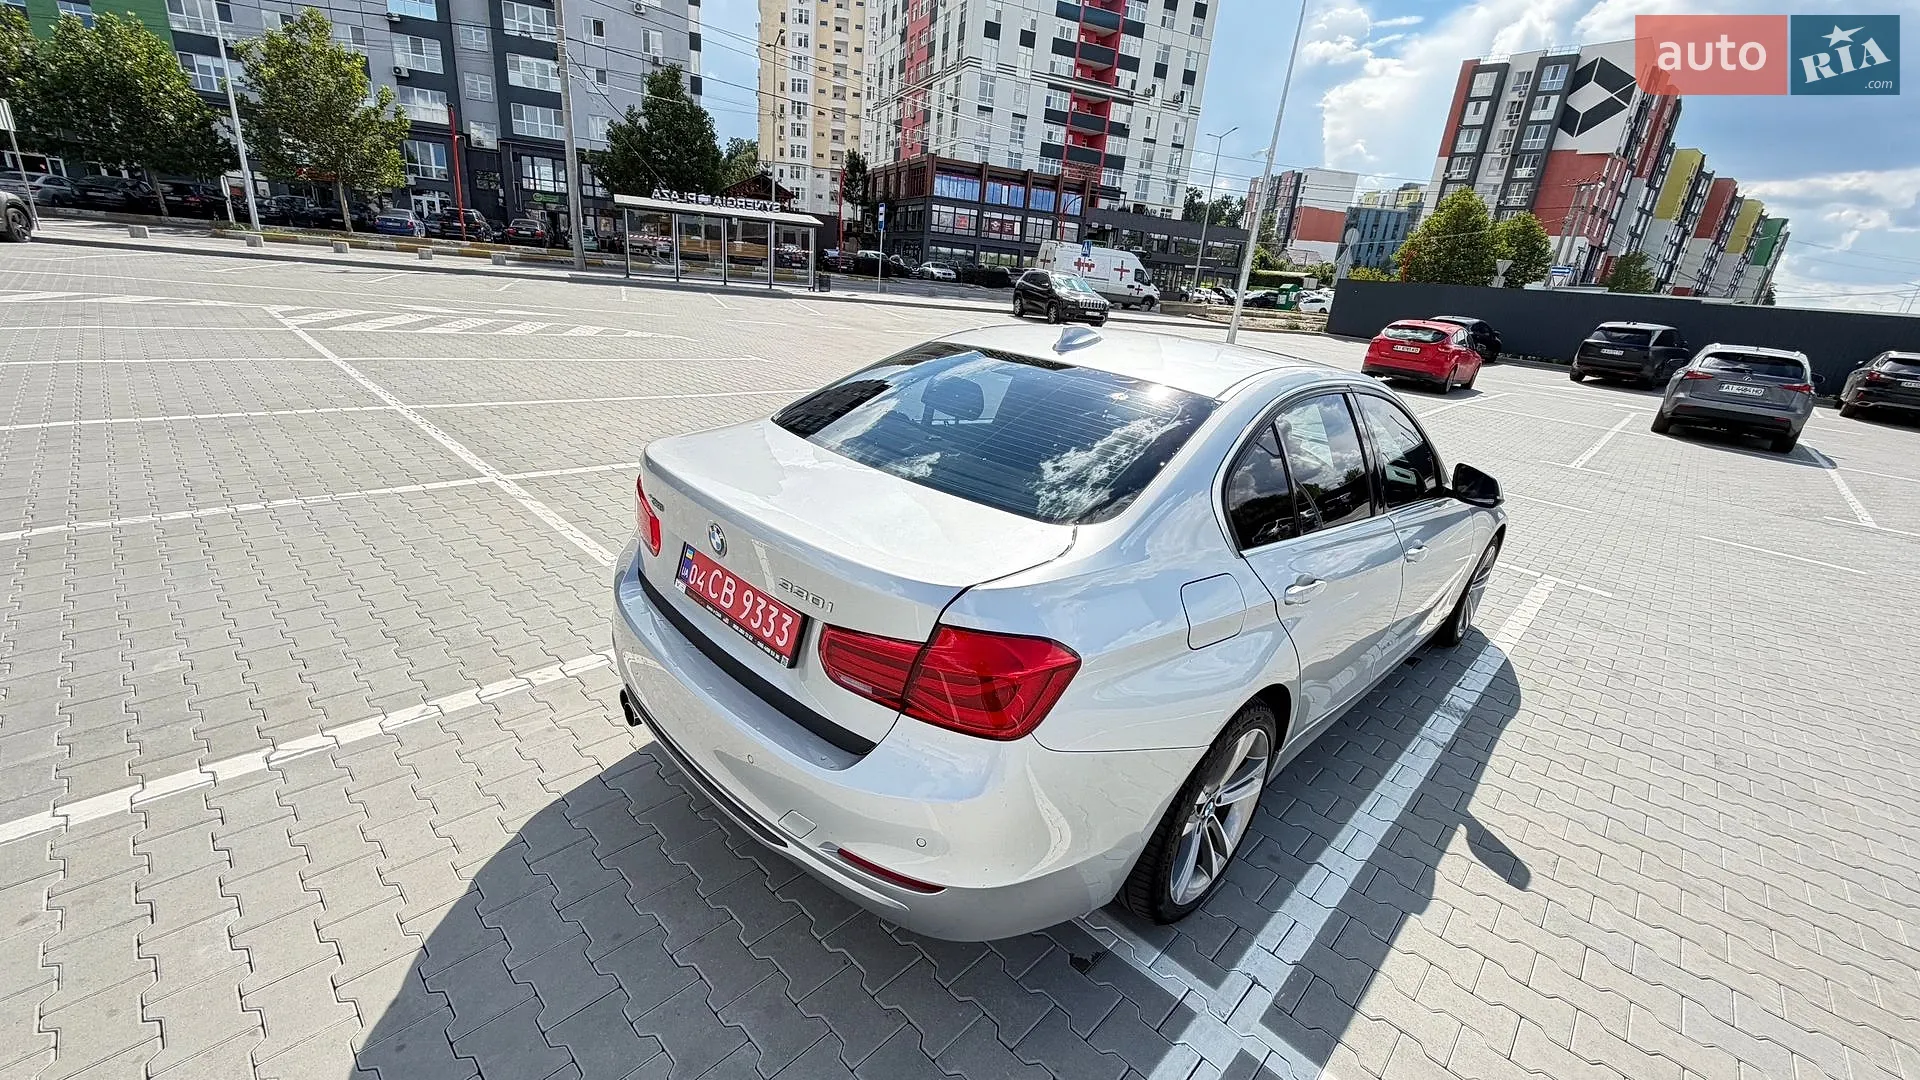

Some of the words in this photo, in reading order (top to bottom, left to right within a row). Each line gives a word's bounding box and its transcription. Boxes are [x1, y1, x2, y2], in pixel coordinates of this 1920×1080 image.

[681, 566, 689, 578] UA
[689, 564, 707, 592] 04
[708, 568, 737, 609] CB
[739, 589, 793, 647] 9333
[778, 577, 834, 614] 330i
